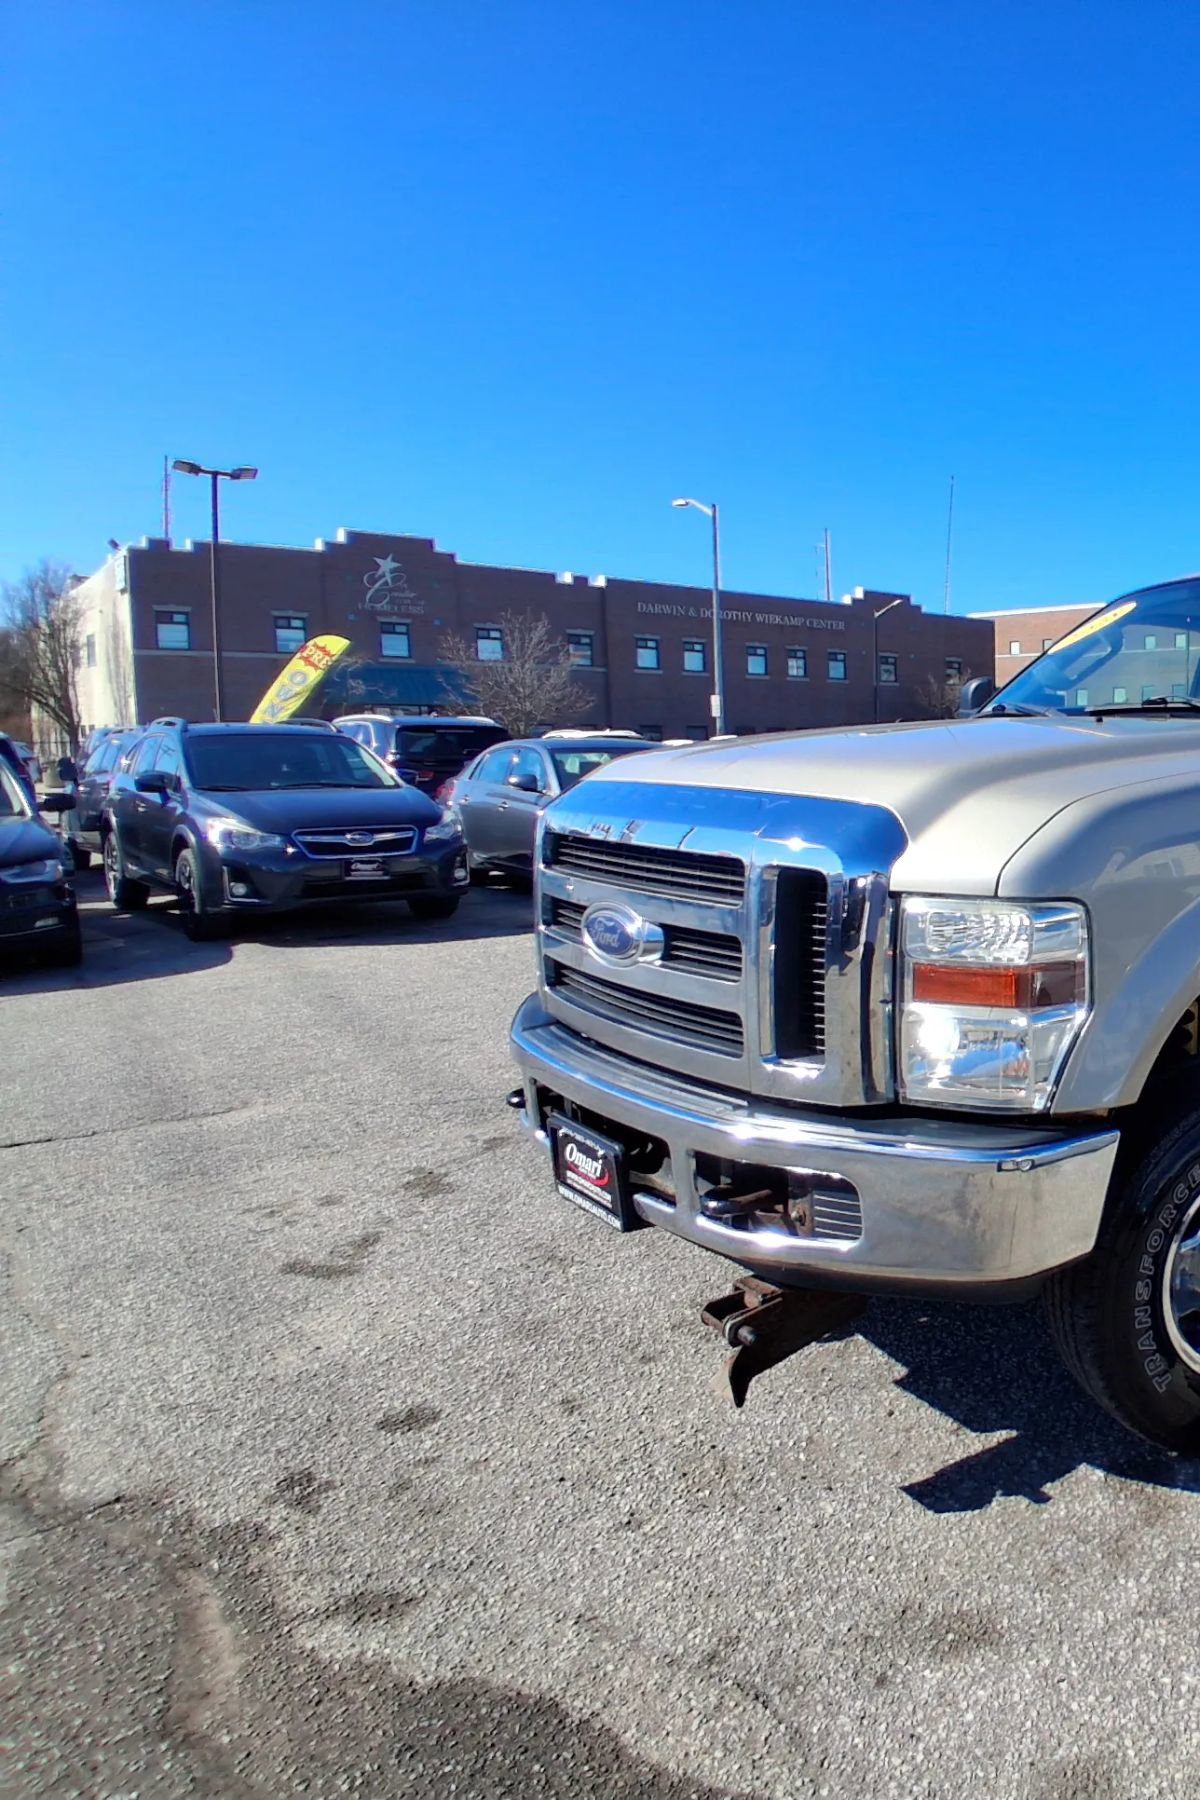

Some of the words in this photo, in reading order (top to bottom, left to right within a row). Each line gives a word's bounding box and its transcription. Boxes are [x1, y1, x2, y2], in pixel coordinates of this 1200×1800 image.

[637, 601, 686, 616] DARWIN
[688, 606, 698, 617] &
[806, 617, 846, 631] CENTER
[588, 916, 621, 948] Ford
[565, 1143, 603, 1178] Omari
